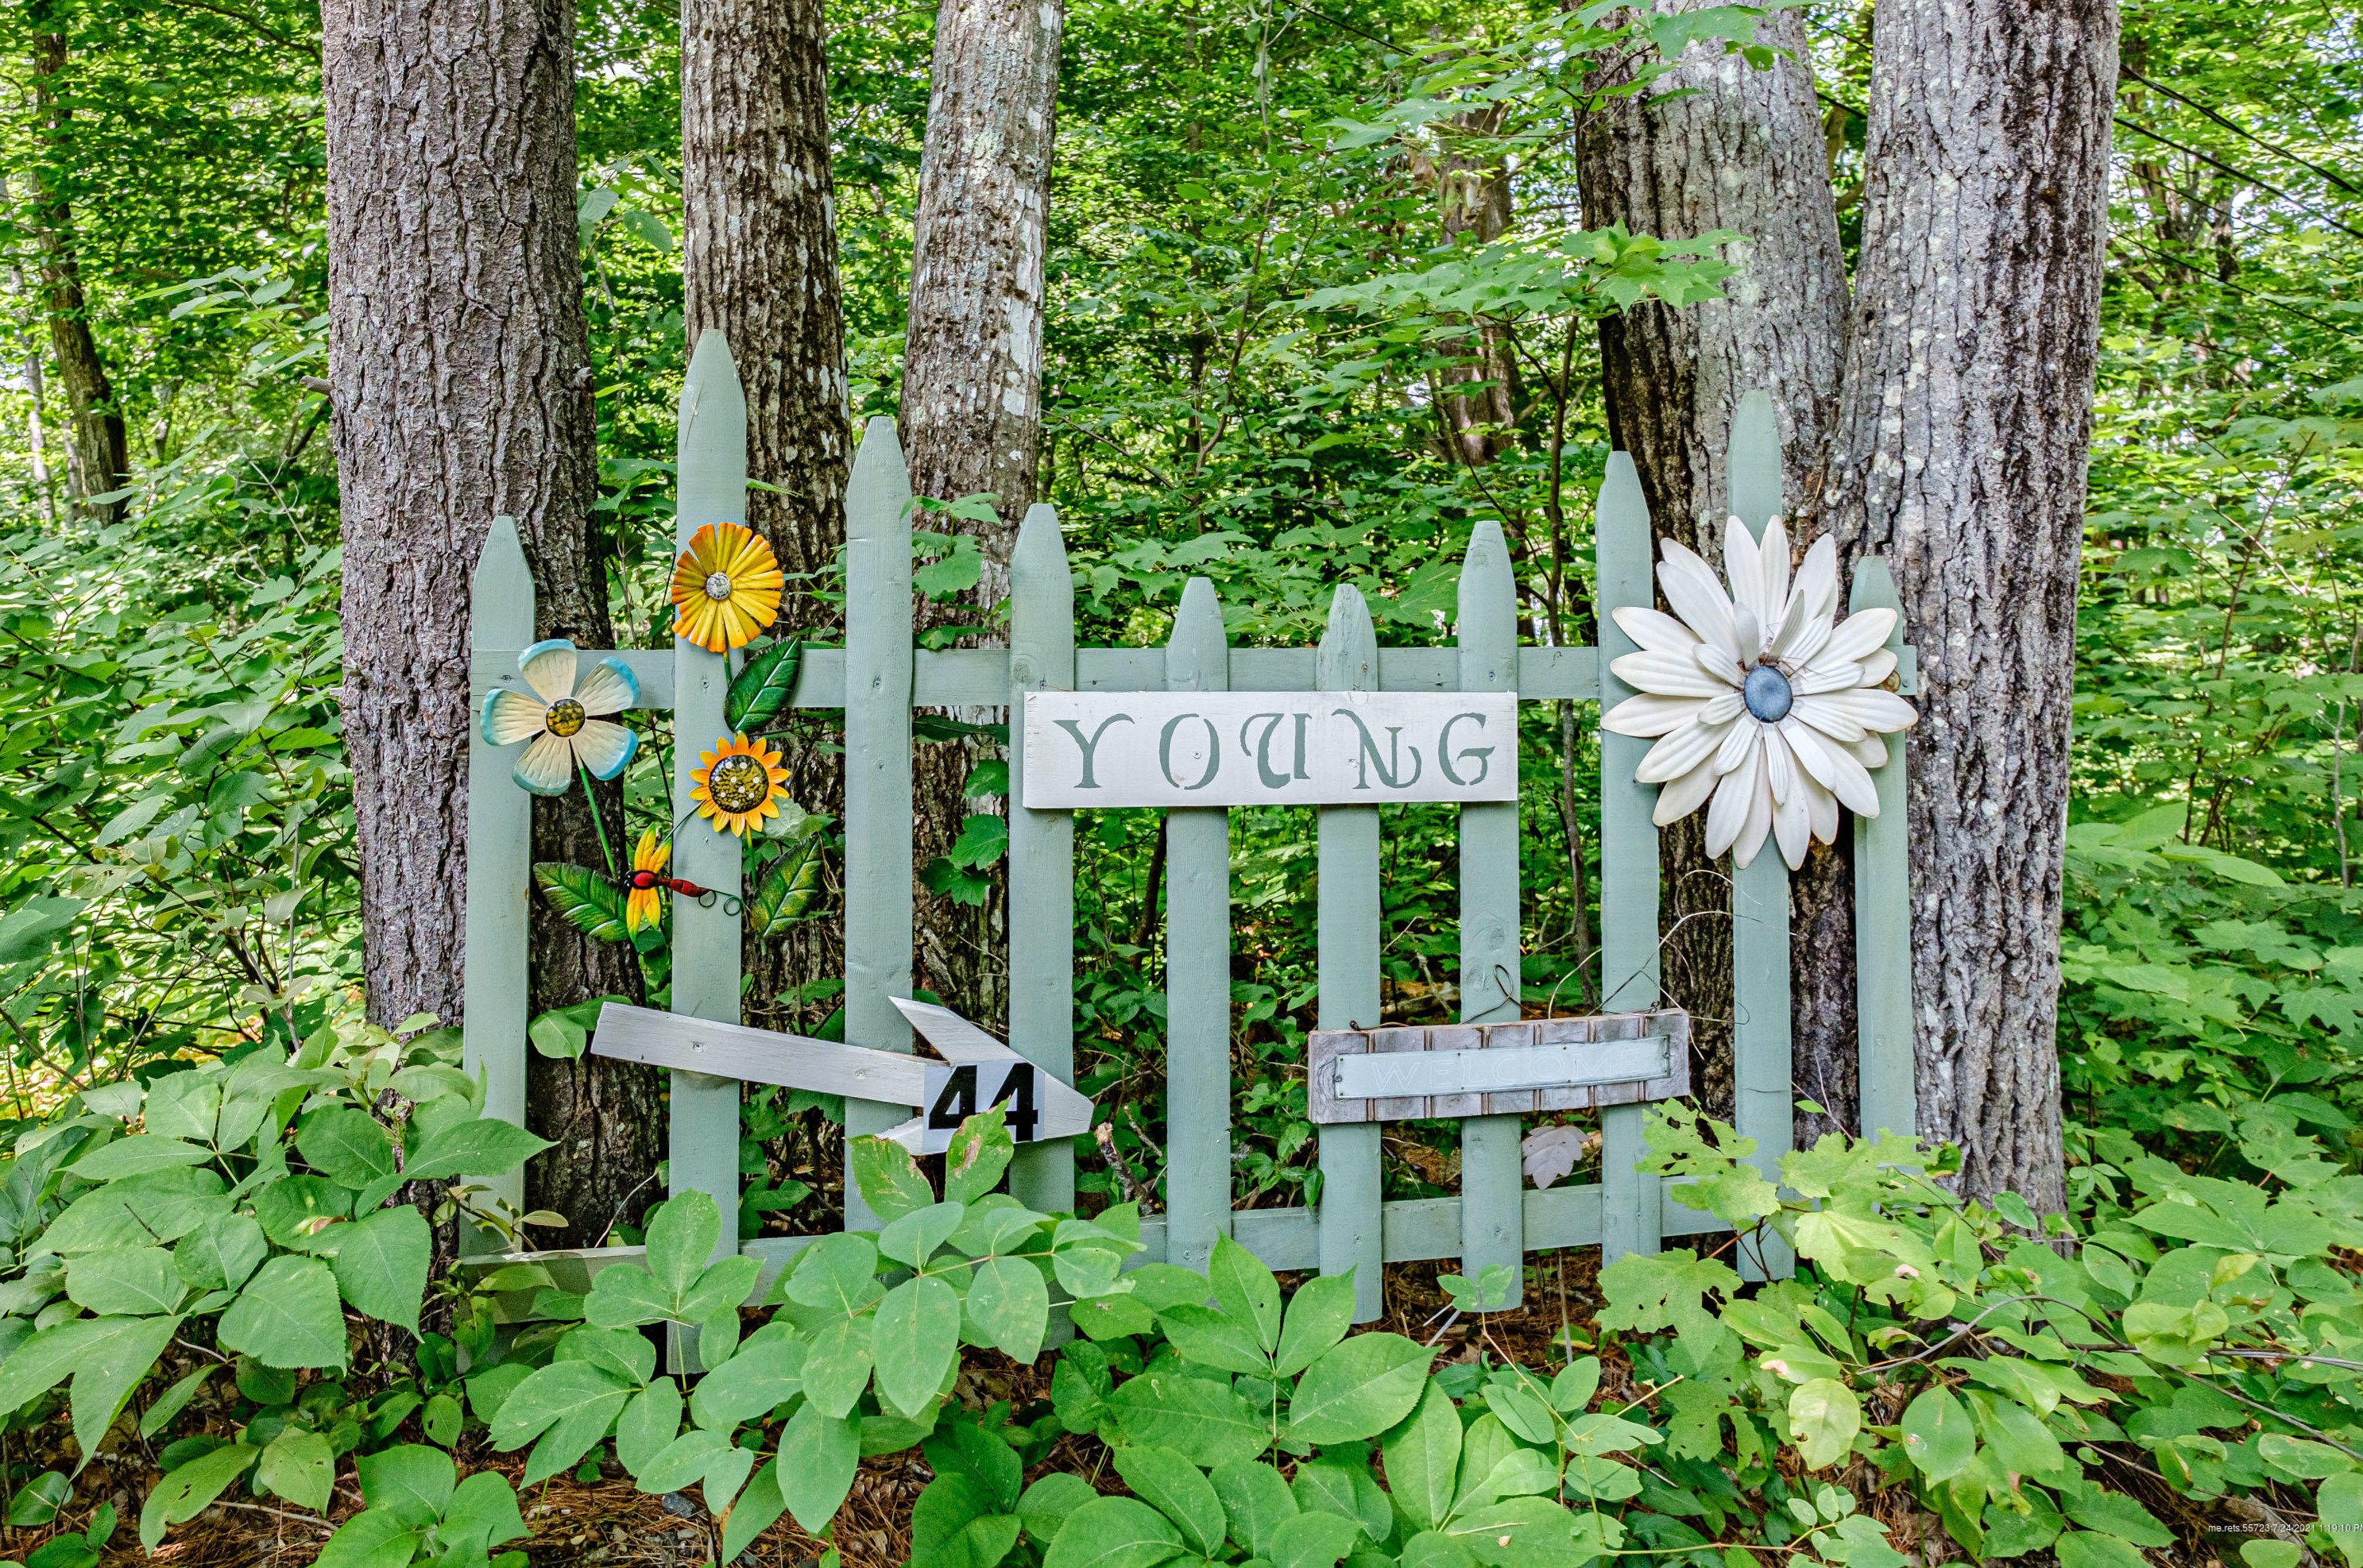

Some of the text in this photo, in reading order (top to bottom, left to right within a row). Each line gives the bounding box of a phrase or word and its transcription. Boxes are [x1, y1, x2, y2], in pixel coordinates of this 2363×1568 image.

[1053, 709, 1496, 790] YOUNG
[928, 1062, 1038, 1141] 44
[1371, 1049, 1645, 1092] WELCOME
